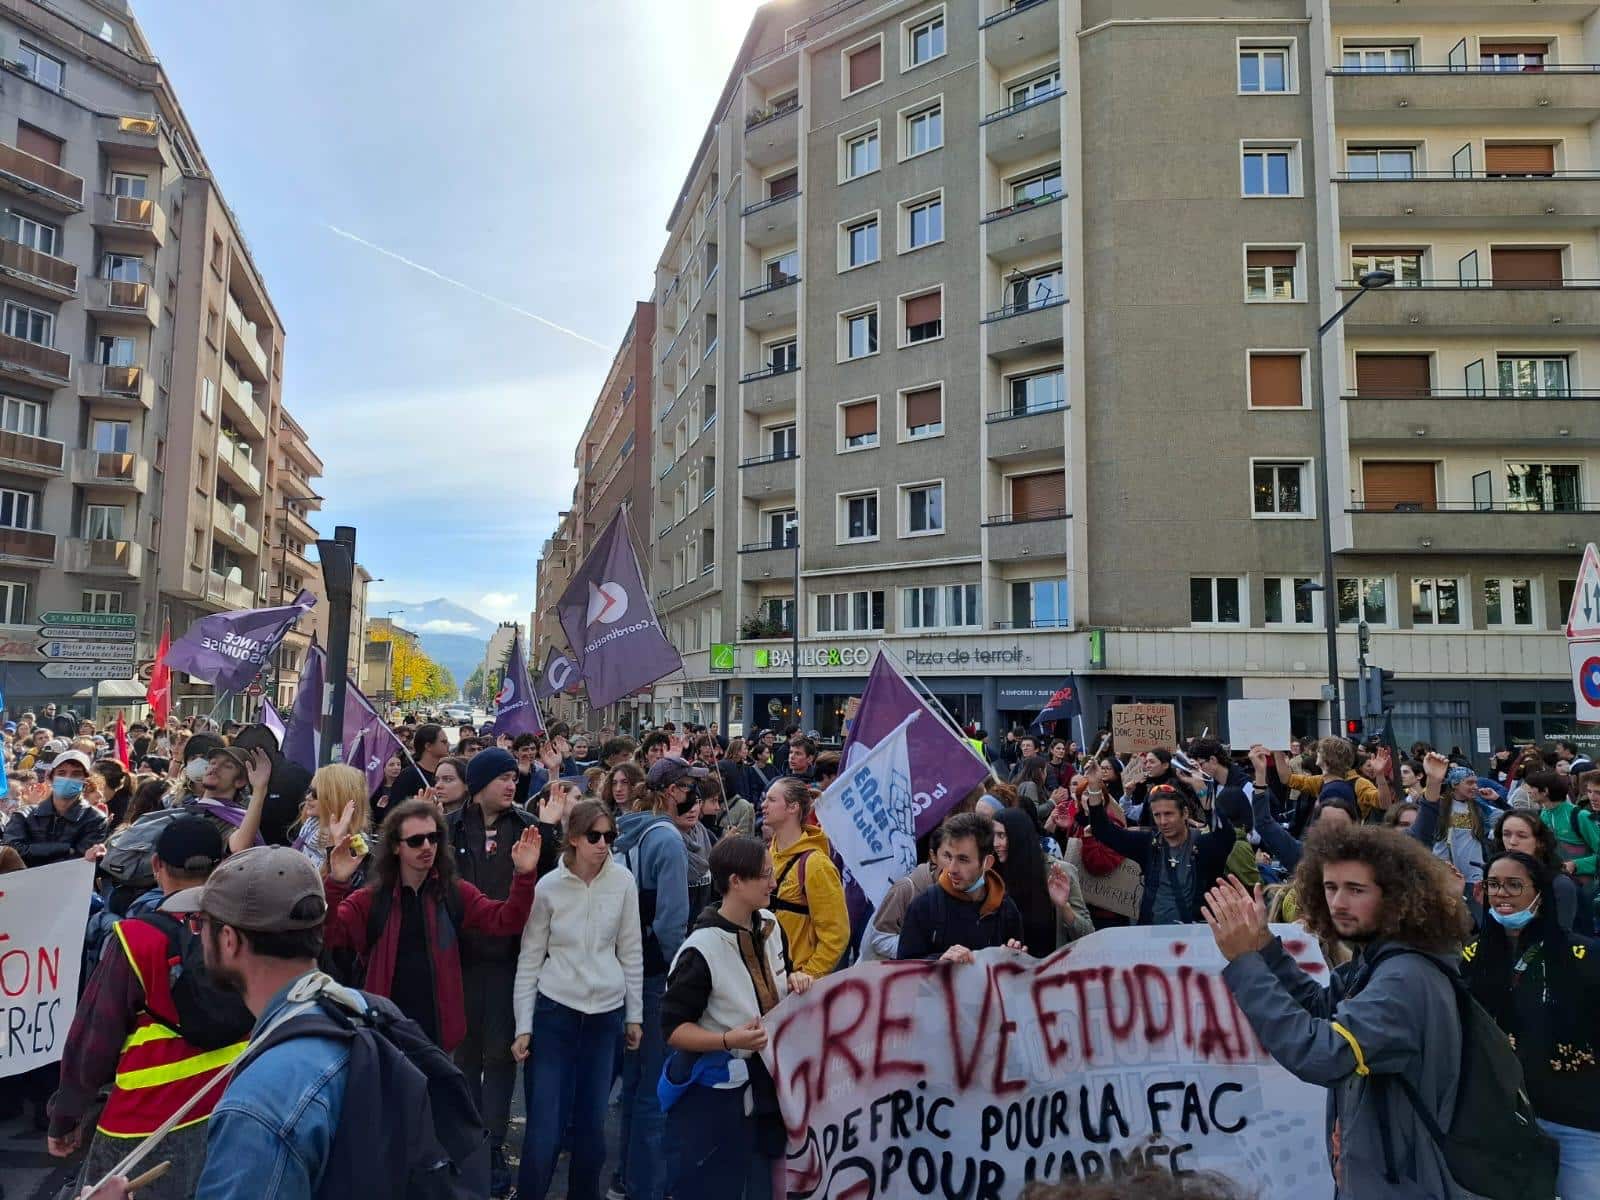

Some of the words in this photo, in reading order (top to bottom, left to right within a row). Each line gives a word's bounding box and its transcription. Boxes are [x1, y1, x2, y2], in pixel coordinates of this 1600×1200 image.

[62, 615, 96, 623] MARTIN
[906, 648, 943, 664] Pizza
[947, 646, 970, 664] de
[975, 645, 1023, 664] terroir
[1134, 713, 1167, 726] PENSE
[1114, 727, 1132, 737] DONC
[1136, 728, 1145, 737] JE
[1148, 728, 1172, 741] SUIS
[823, 1107, 863, 1167] DE
[981, 1090, 1070, 1151] POUR
[1079, 1082, 1130, 1144] LA
[1147, 1080, 1248, 1138] FAC
[880, 1146, 1006, 1200] POUR
